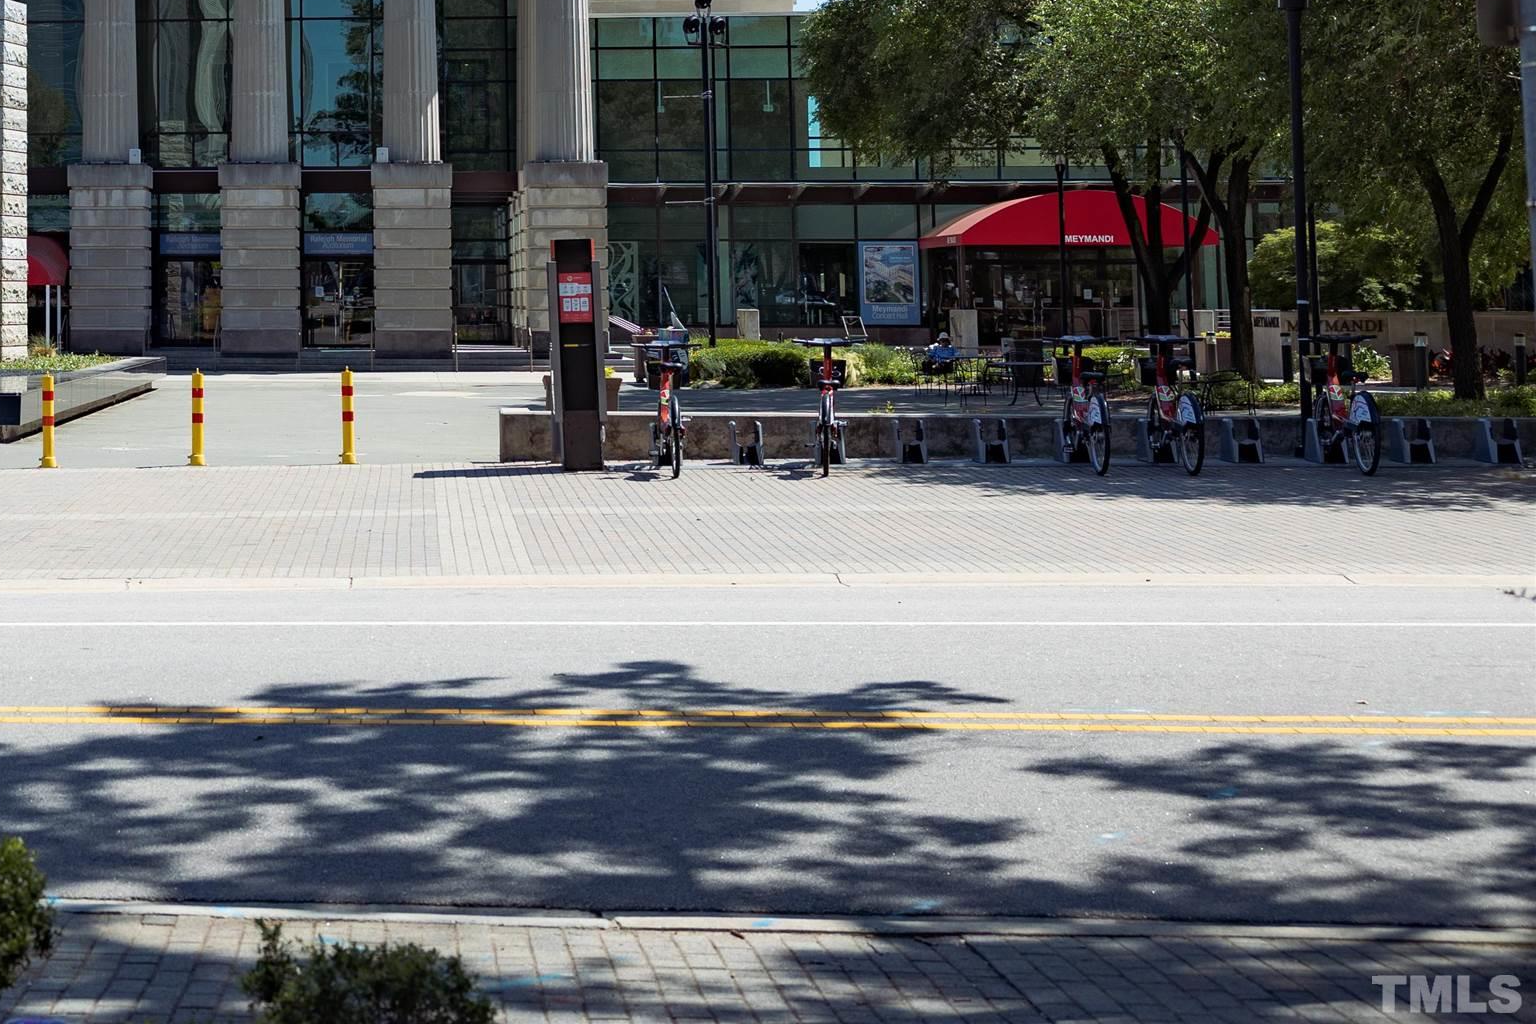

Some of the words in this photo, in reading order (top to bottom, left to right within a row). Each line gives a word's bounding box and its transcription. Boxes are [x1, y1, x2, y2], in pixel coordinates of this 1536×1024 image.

[1065, 235, 1114, 243] MEYMANDI
[872, 304, 908, 313] Meymandi
[1287, 319, 1384, 332] MMANDI
